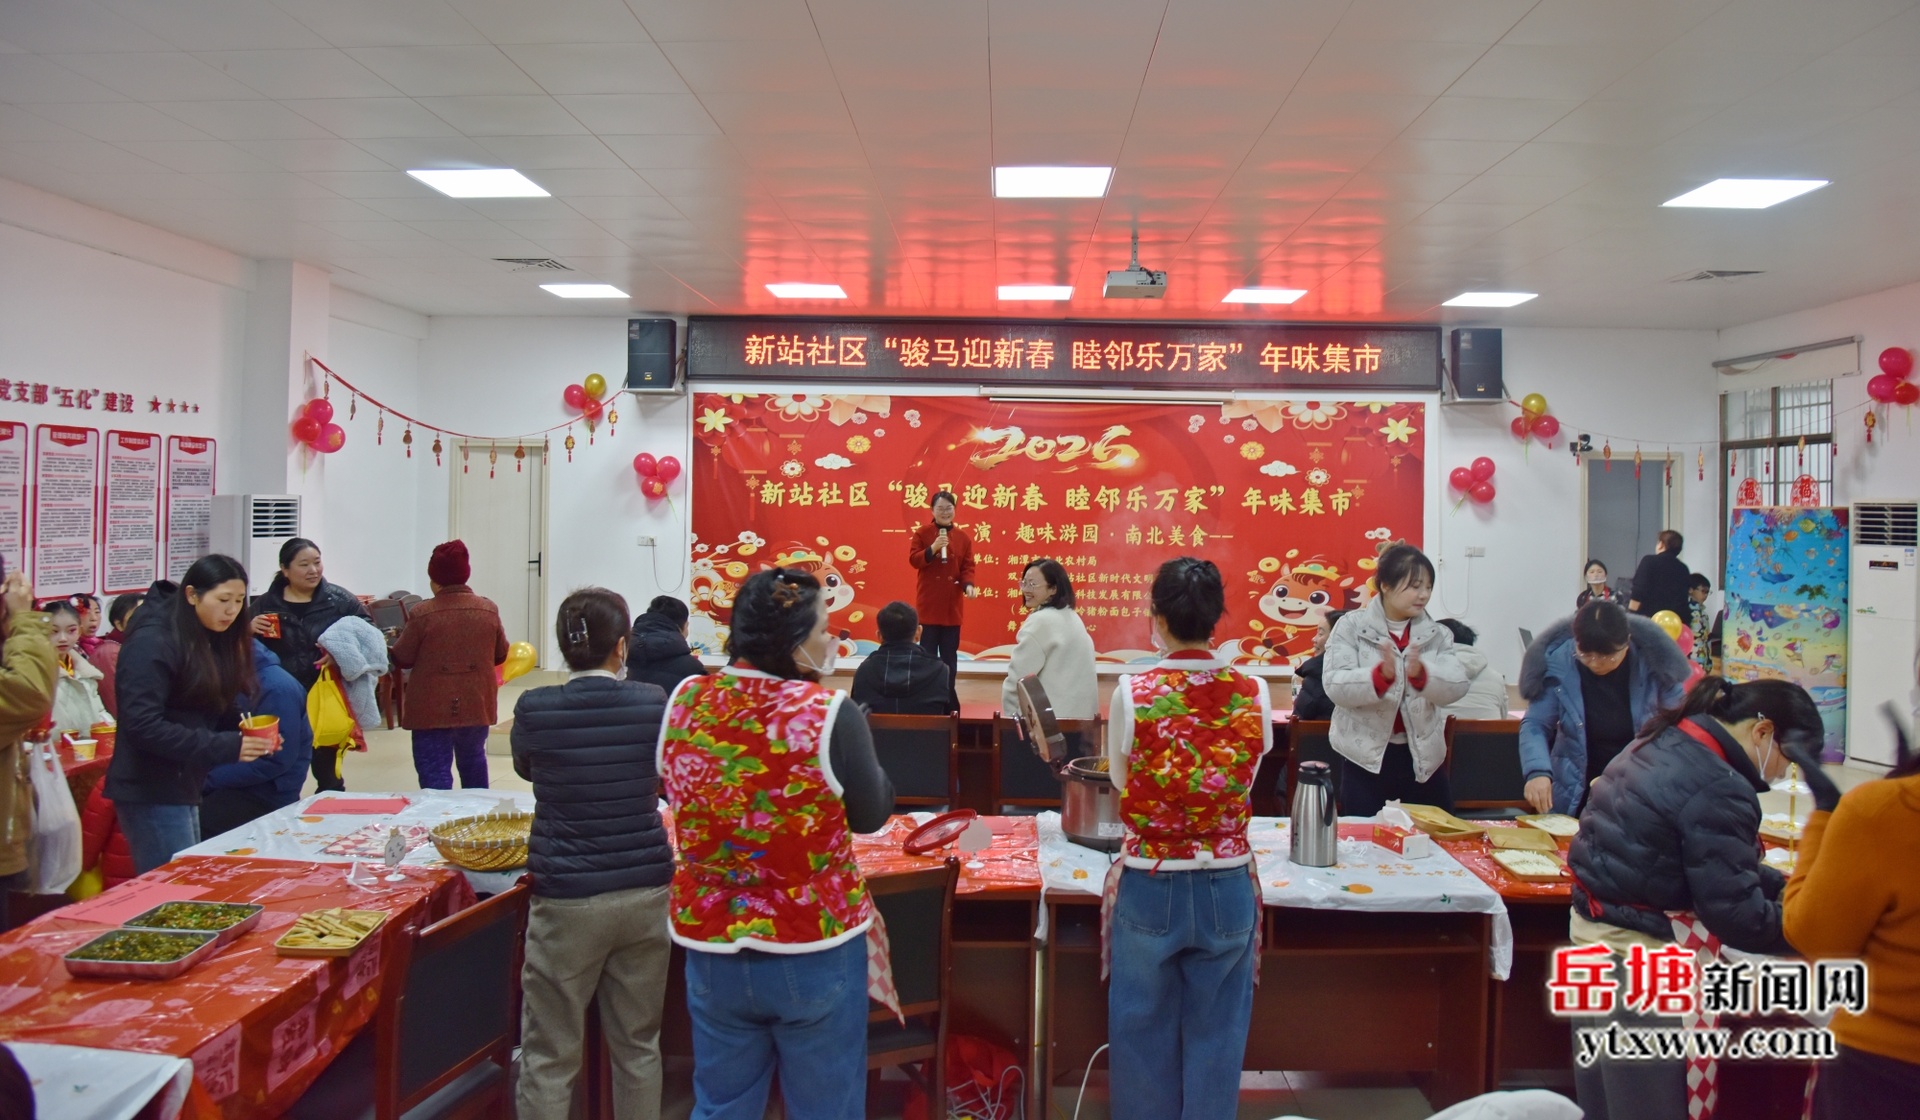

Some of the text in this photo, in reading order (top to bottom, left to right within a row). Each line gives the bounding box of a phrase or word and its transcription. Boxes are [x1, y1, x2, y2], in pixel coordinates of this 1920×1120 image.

[745, 335, 1382, 374] 新站社区 “骏马迎新春 睦邻乐万家” 年味集市
[969, 424, 1140, 473] 2026
[759, 480, 871, 507] 新站社区
[1065, 484, 1225, 514] 睦邻乐万家”
[1241, 487, 1353, 517] 年味集市
